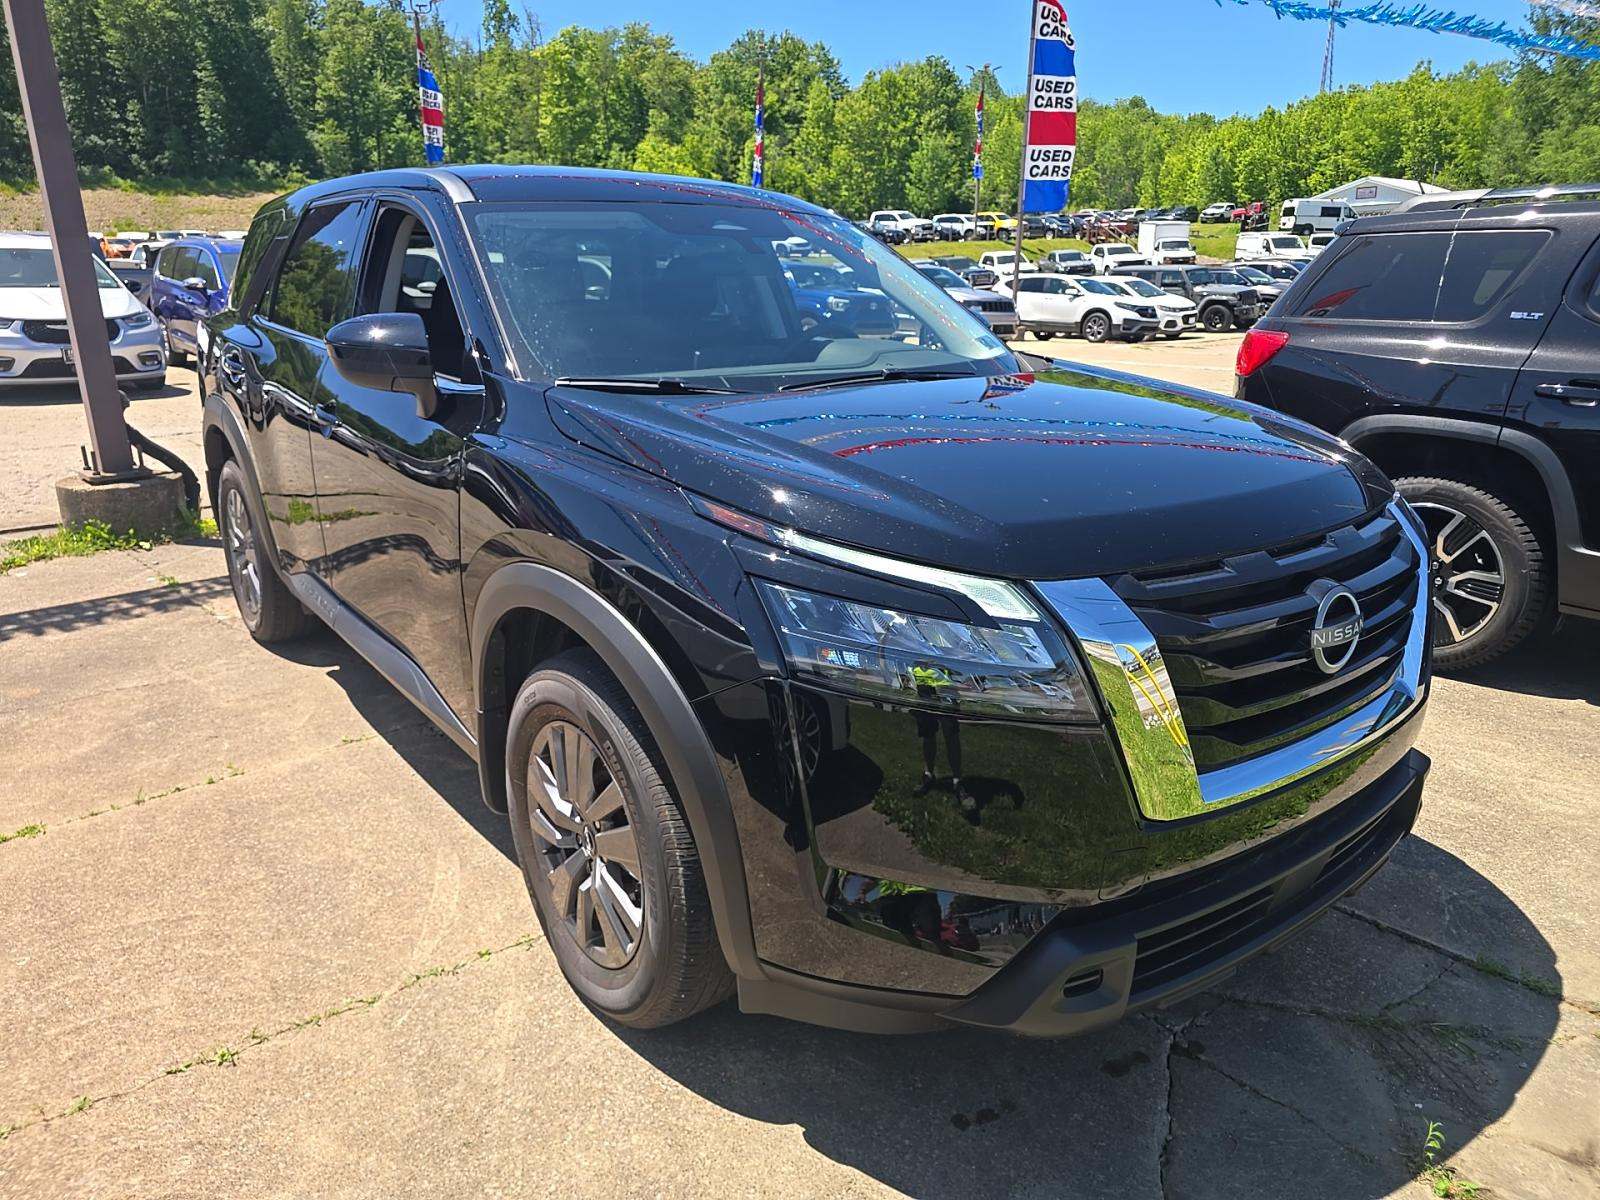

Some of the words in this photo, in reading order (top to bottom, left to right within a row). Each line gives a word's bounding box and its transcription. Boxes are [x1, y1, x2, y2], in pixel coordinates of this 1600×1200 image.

[1035, 79, 1075, 94] USED
[1034, 94, 1074, 109] CARS
[1030, 149, 1072, 162] USED
[1029, 164, 1070, 177] CARS
